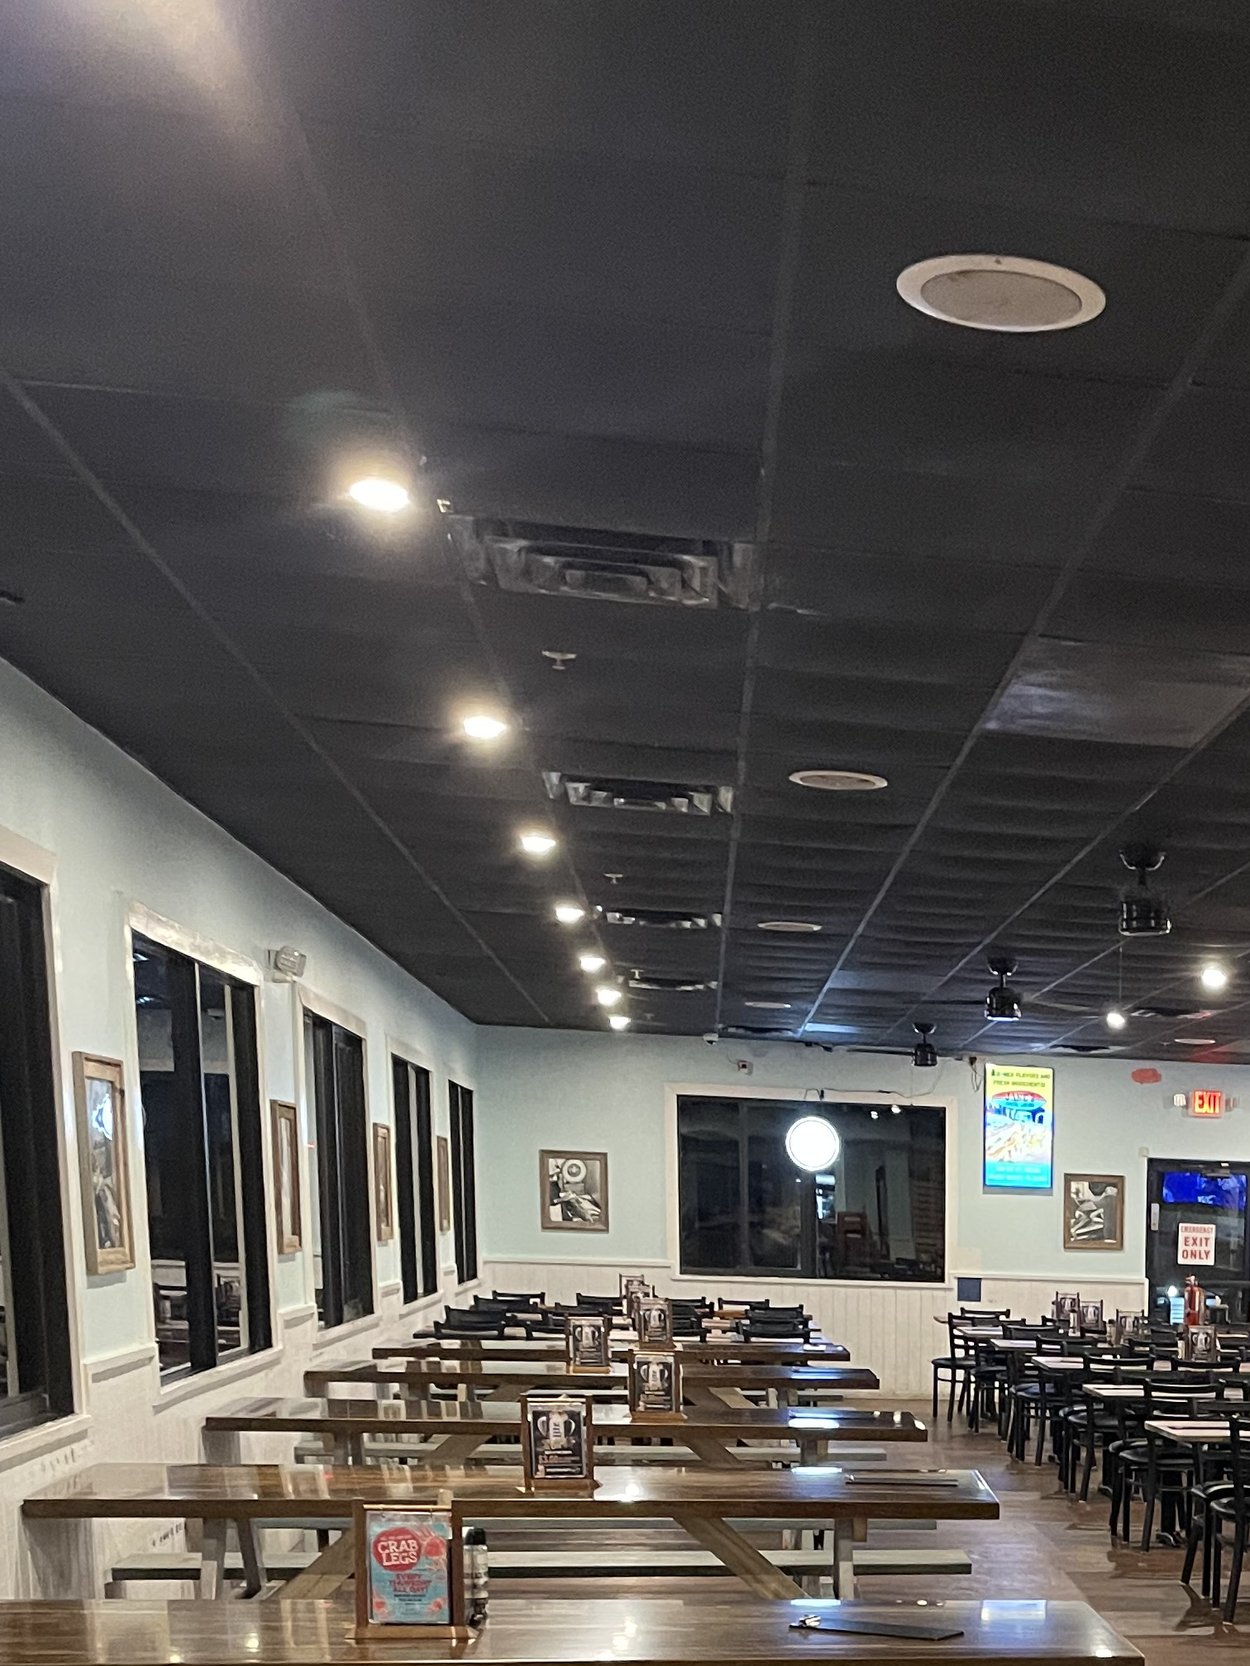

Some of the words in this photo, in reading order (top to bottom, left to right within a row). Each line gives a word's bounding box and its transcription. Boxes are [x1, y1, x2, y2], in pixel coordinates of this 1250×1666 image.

[1194, 1091, 1221, 1114] EXIT
[1184, 1236, 1210, 1247] EXIT
[1181, 1249, 1211, 1260] ONLY
[377, 1539, 419, 1554] CRAB
[381, 1551, 418, 1566] LEGS
